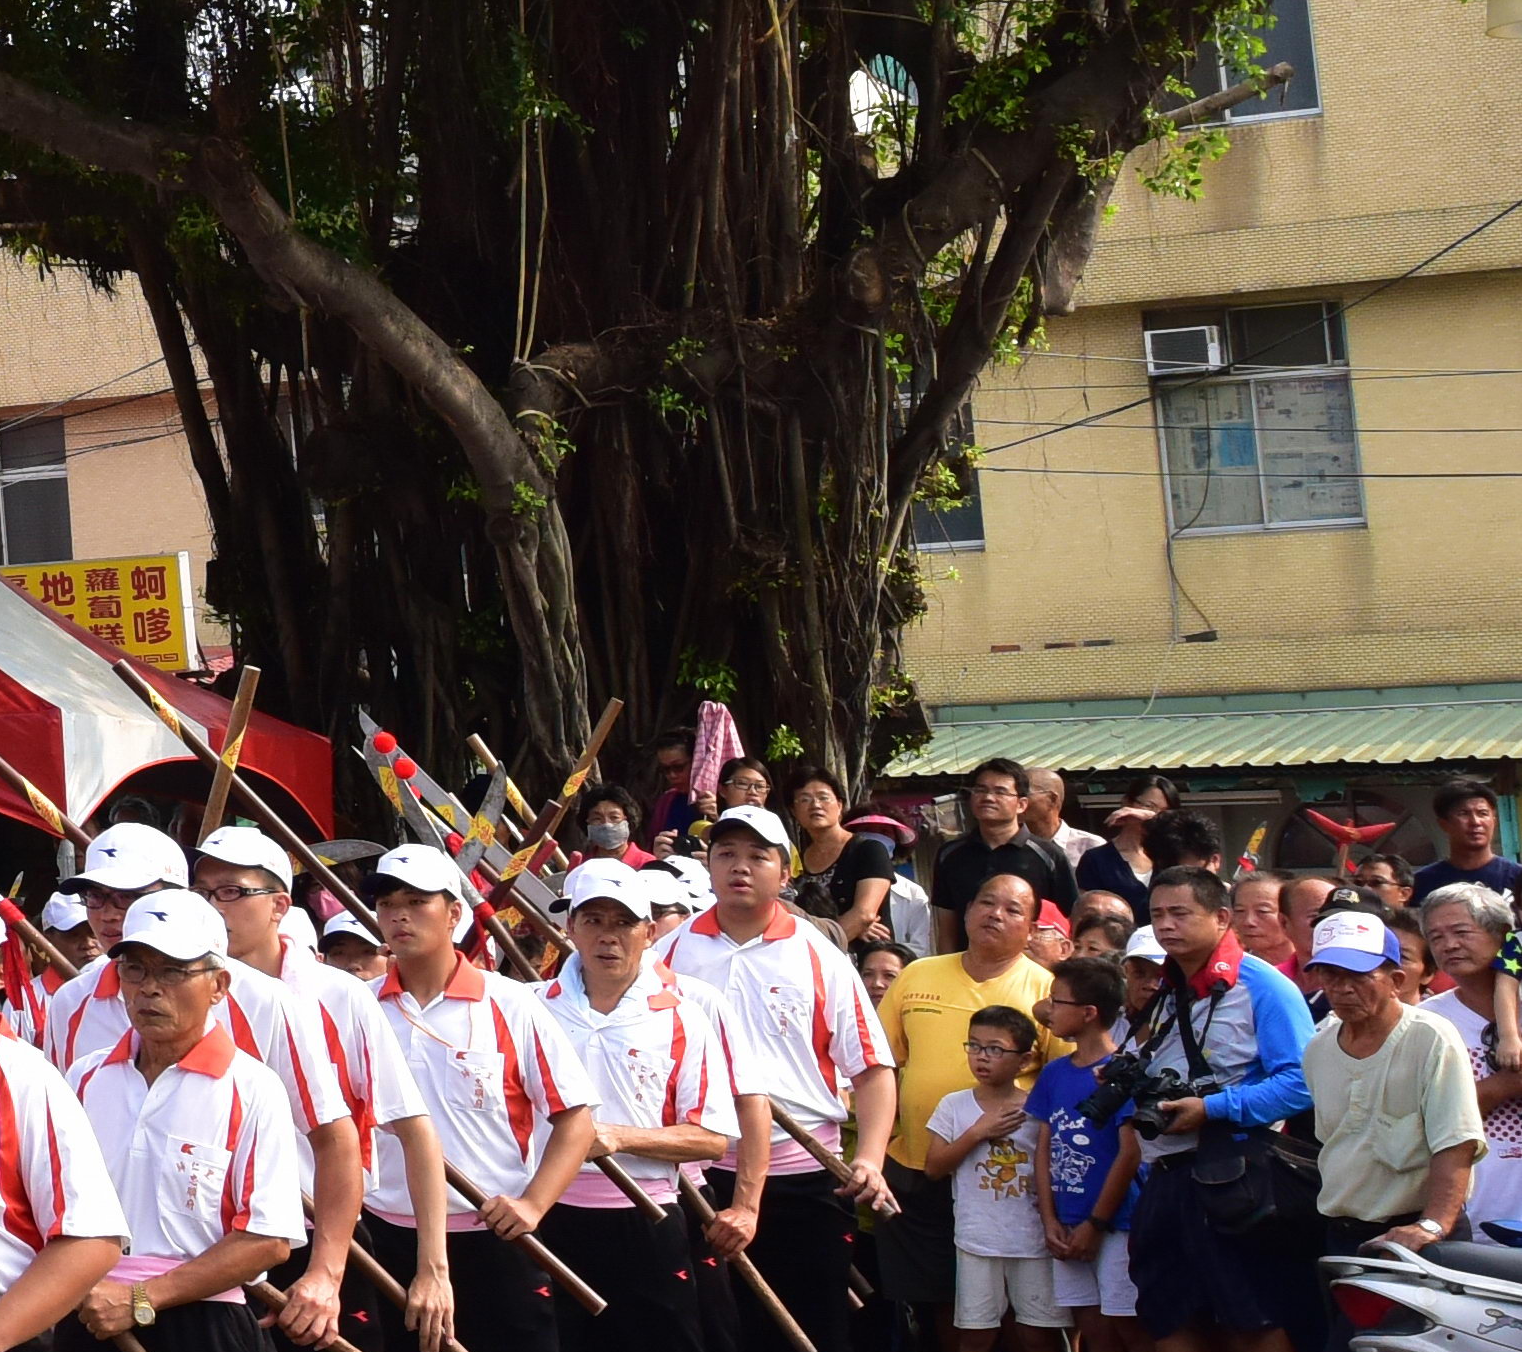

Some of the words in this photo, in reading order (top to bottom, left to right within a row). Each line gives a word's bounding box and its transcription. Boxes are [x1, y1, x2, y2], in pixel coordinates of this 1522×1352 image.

[85, 567, 126, 645] 蘿蔔糕
[131, 566, 172, 644] 蚵嗲
